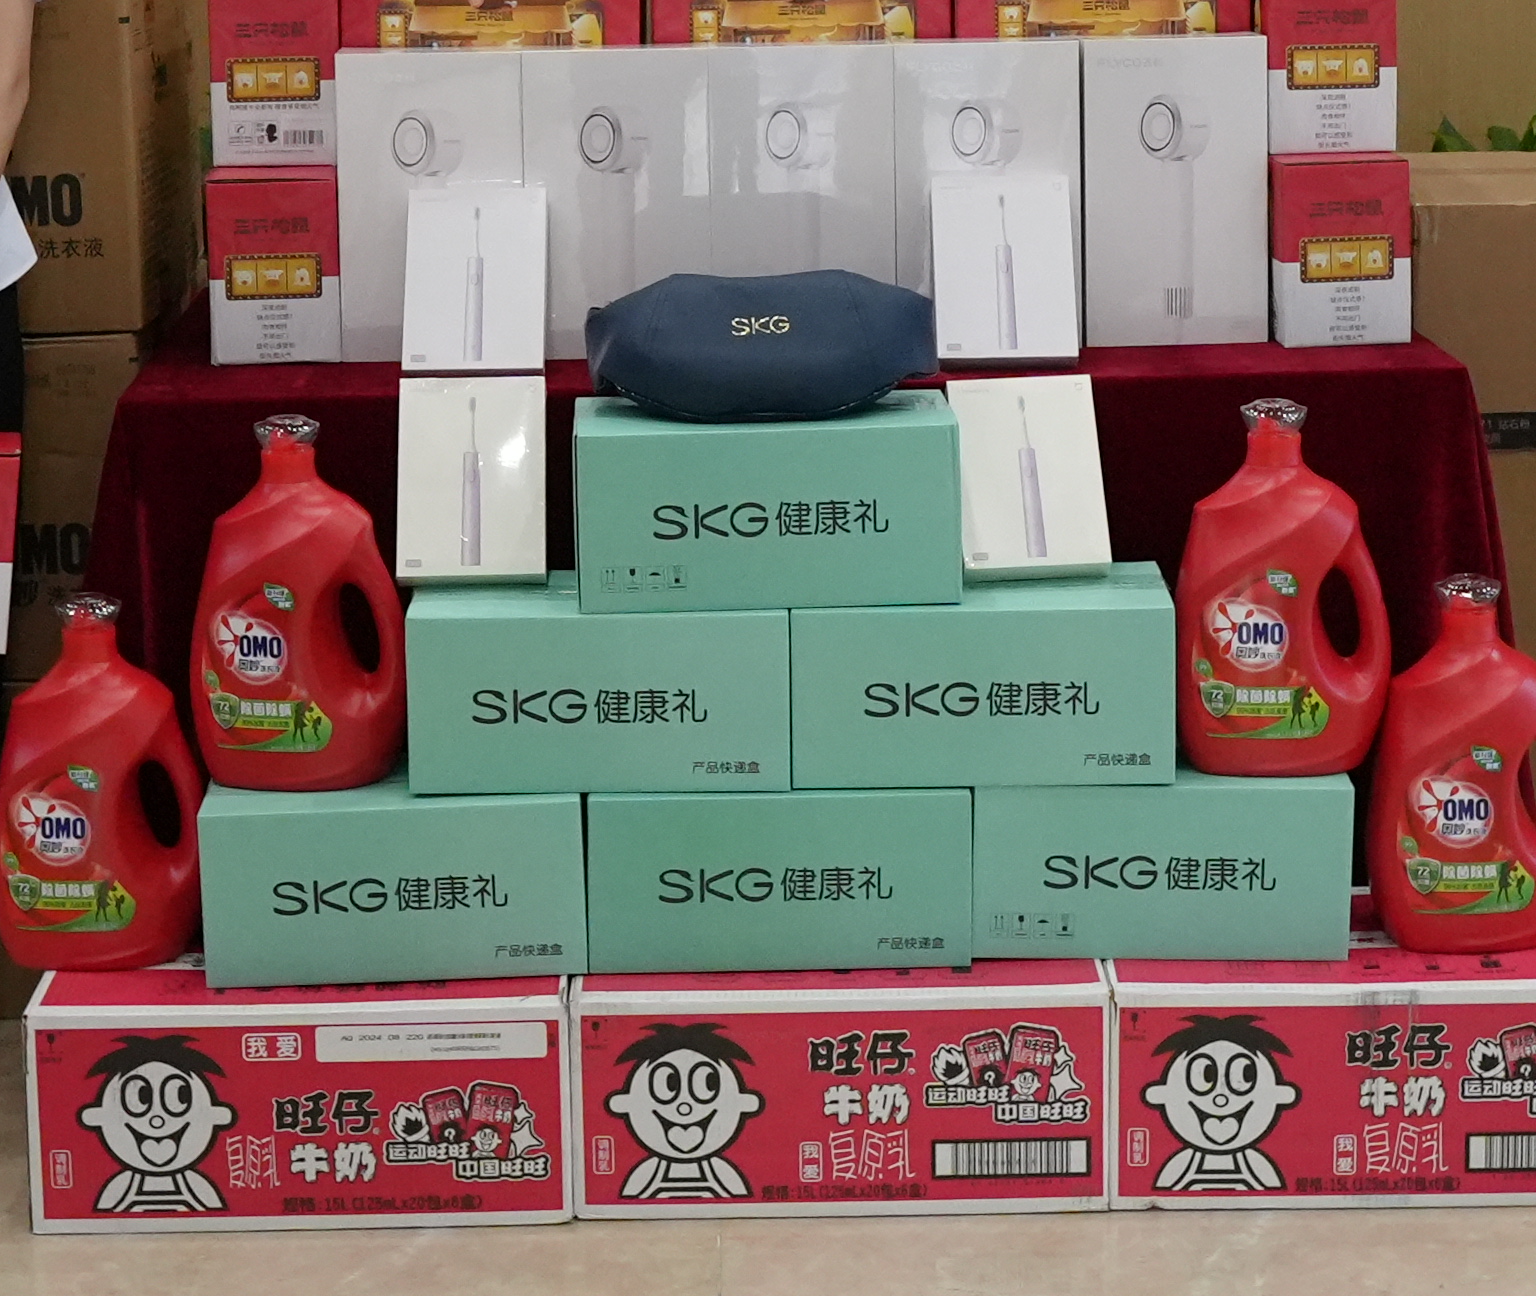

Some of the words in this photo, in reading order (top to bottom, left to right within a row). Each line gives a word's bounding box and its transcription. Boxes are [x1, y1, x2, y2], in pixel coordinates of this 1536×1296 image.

[731, 315, 790, 336] SKG
[652, 502, 769, 540] SKG
[775, 499, 889, 536] 健康礼
[1238, 622, 1283, 645] OMO
[239, 635, 282, 658] OMO
[472, 689, 587, 724] SKG
[594, 688, 707, 724] 健康礼
[864, 682, 979, 717] SKG
[986, 681, 1099, 716] 健康礼
[692, 761, 760, 774] 产品快递盒
[1083, 753, 1151, 766] 产品快递盒
[1443, 798, 1489, 821] OMO
[41, 817, 86, 839] OMO
[658, 868, 774, 903] SKG
[780, 866, 893, 902] 健康礼
[1043, 855, 1158, 890] SKG
[1165, 856, 1276, 891] 健康礼
[272, 878, 388, 916] SKG
[394, 873, 508, 912] 健康礼
[495, 944, 563, 958] 产品快递盒
[877, 936, 945, 950] 产品快递盒
[246, 1035, 298, 1058] 我爱
[808, 1030, 915, 1076] 旺仔
[1345, 1023, 1451, 1070] 旺仔
[824, 1084, 910, 1125] 牛奶
[928, 1087, 1010, 1103] 运动旺旺
[1360, 1076, 1446, 1117] 牛奶
[274, 1089, 379, 1134] 旺仔
[997, 1104, 1086, 1120] 中国旺旺
[291, 1142, 376, 1183] 牛奶
[389, 1144, 471, 1160] 运动旺旺
[458, 1159, 547, 1178] 中国旺旺
